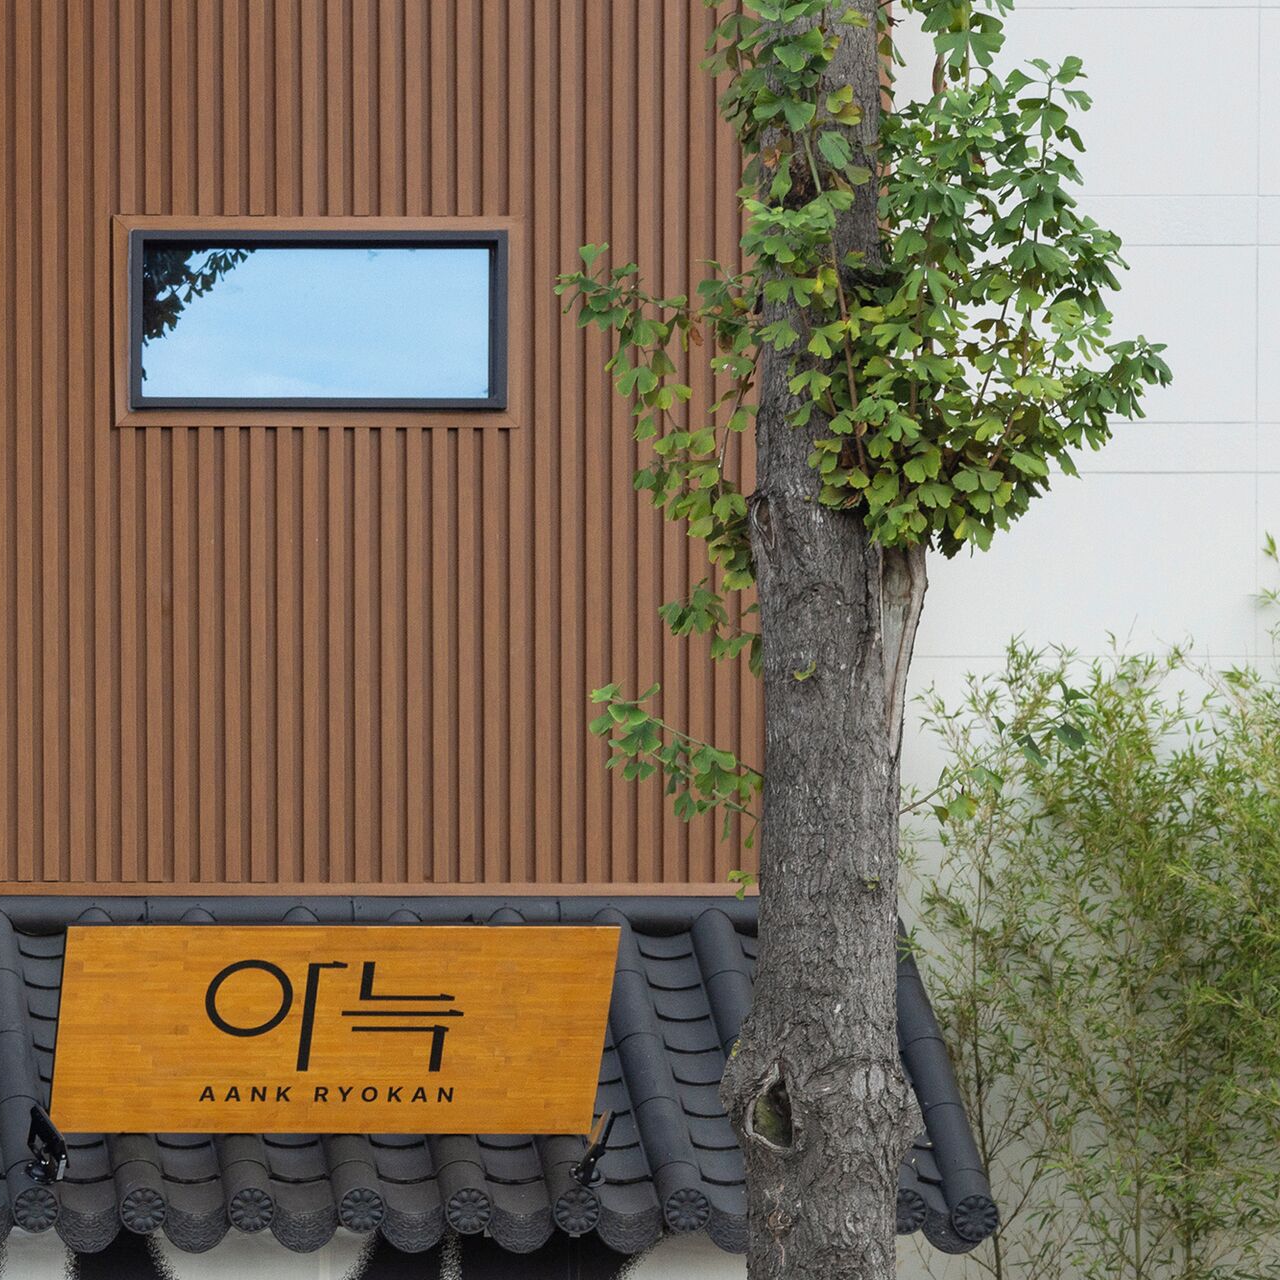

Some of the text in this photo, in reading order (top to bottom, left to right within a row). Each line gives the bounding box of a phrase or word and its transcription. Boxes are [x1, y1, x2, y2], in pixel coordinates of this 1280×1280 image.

[205, 959, 464, 1072] 아늑
[199, 1086, 455, 1103] AANK RYOKAN
